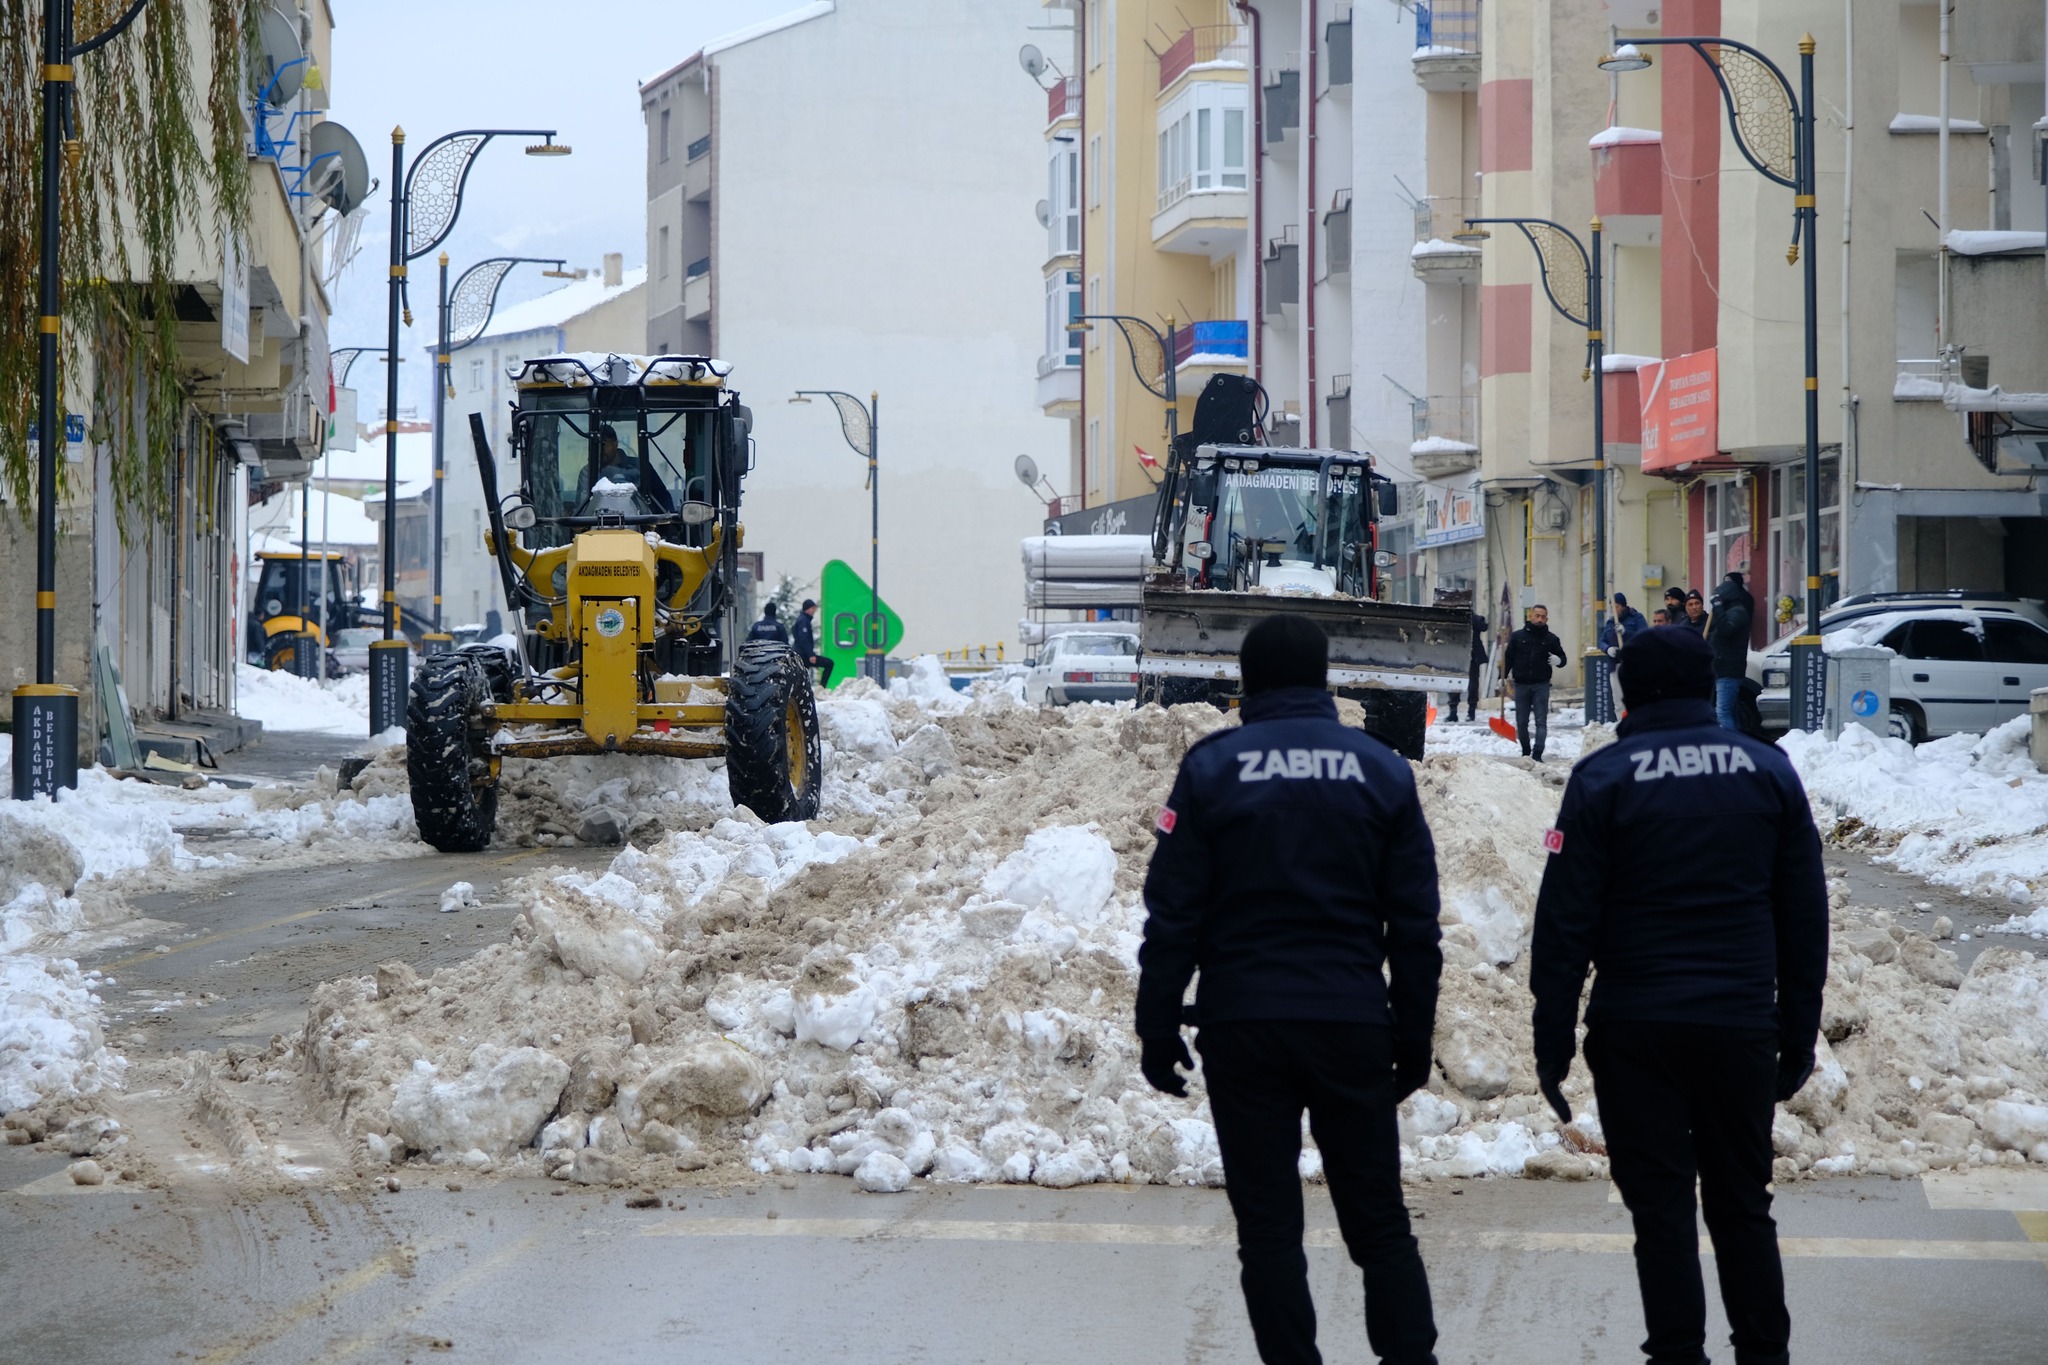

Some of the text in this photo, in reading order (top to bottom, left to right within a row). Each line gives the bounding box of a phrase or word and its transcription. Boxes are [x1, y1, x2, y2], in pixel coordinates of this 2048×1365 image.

[1302, 476, 1358, 495] BELDİYESİ
[833, 611, 887, 649] GO
[1237, 749, 1366, 783] ZABITA
[1629, 744, 1756, 782] ZABITA
